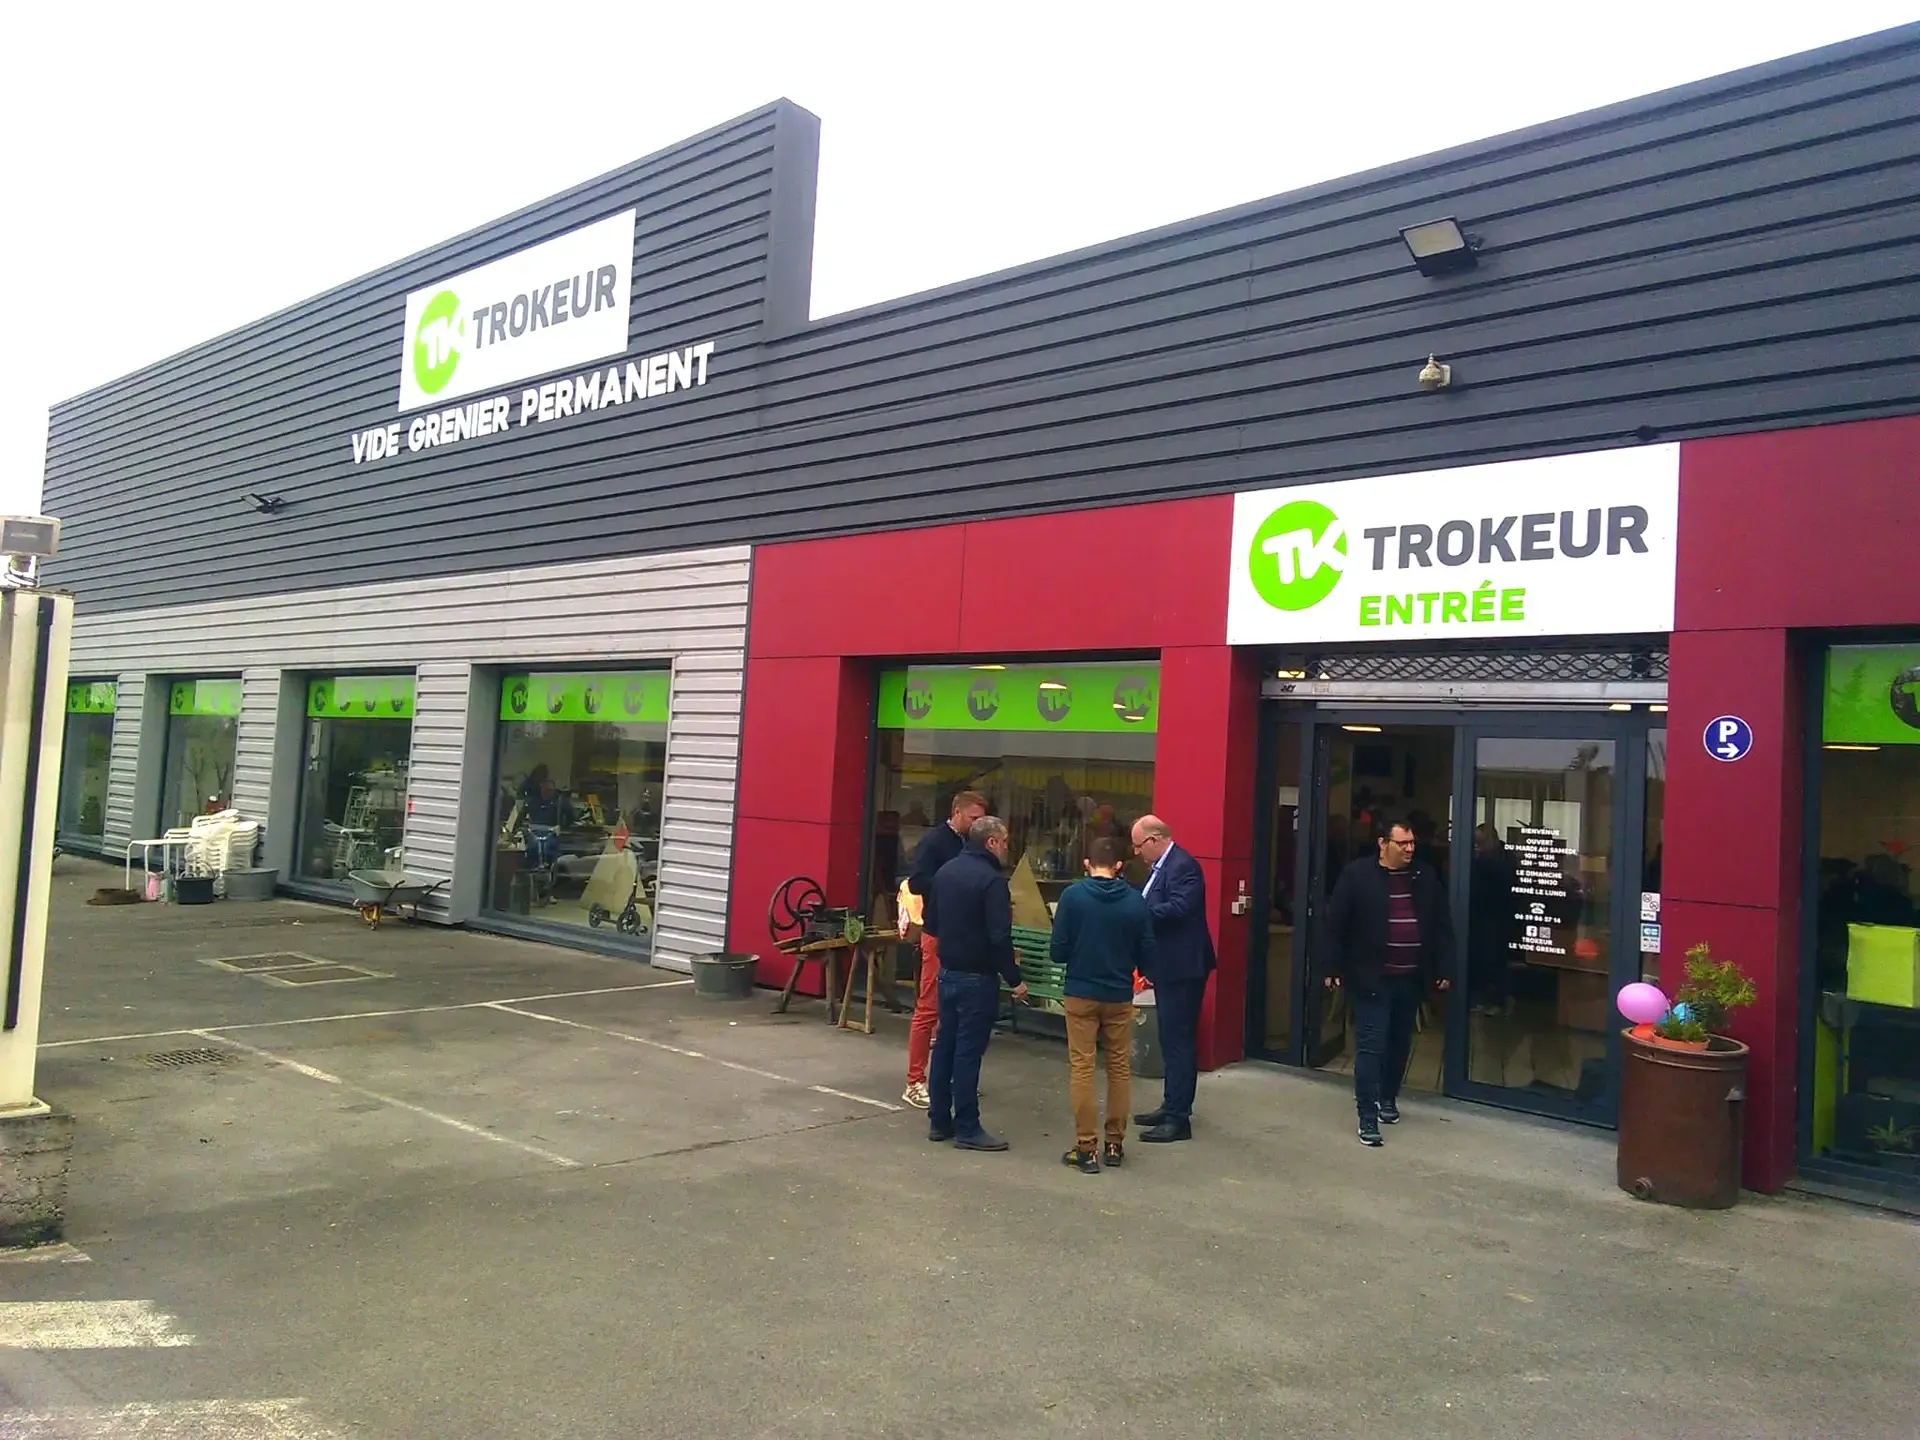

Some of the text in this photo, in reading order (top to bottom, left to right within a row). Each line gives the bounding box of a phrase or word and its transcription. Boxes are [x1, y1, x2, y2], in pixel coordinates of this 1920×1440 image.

[473, 264, 617, 349] TROKEUR
[352, 341, 715, 465] VIDE GRENIER PERMANENT
[1363, 505, 1649, 571] TROKEUR
[1359, 580, 1526, 626] ENTRÉE
[1719, 721, 1738, 742] P
[1521, 828, 1560, 836] BIENVENUE
[1526, 838, 1553, 846] OUVERT
[1526, 870, 1563, 879] DIMANCHE
[1511, 886, 1534, 895] FERMÉ
[1522, 936, 1552, 945] TROKEUR
[1518, 943, 1534, 951] VIDE
[1535, 945, 1566, 955] GRENIER
